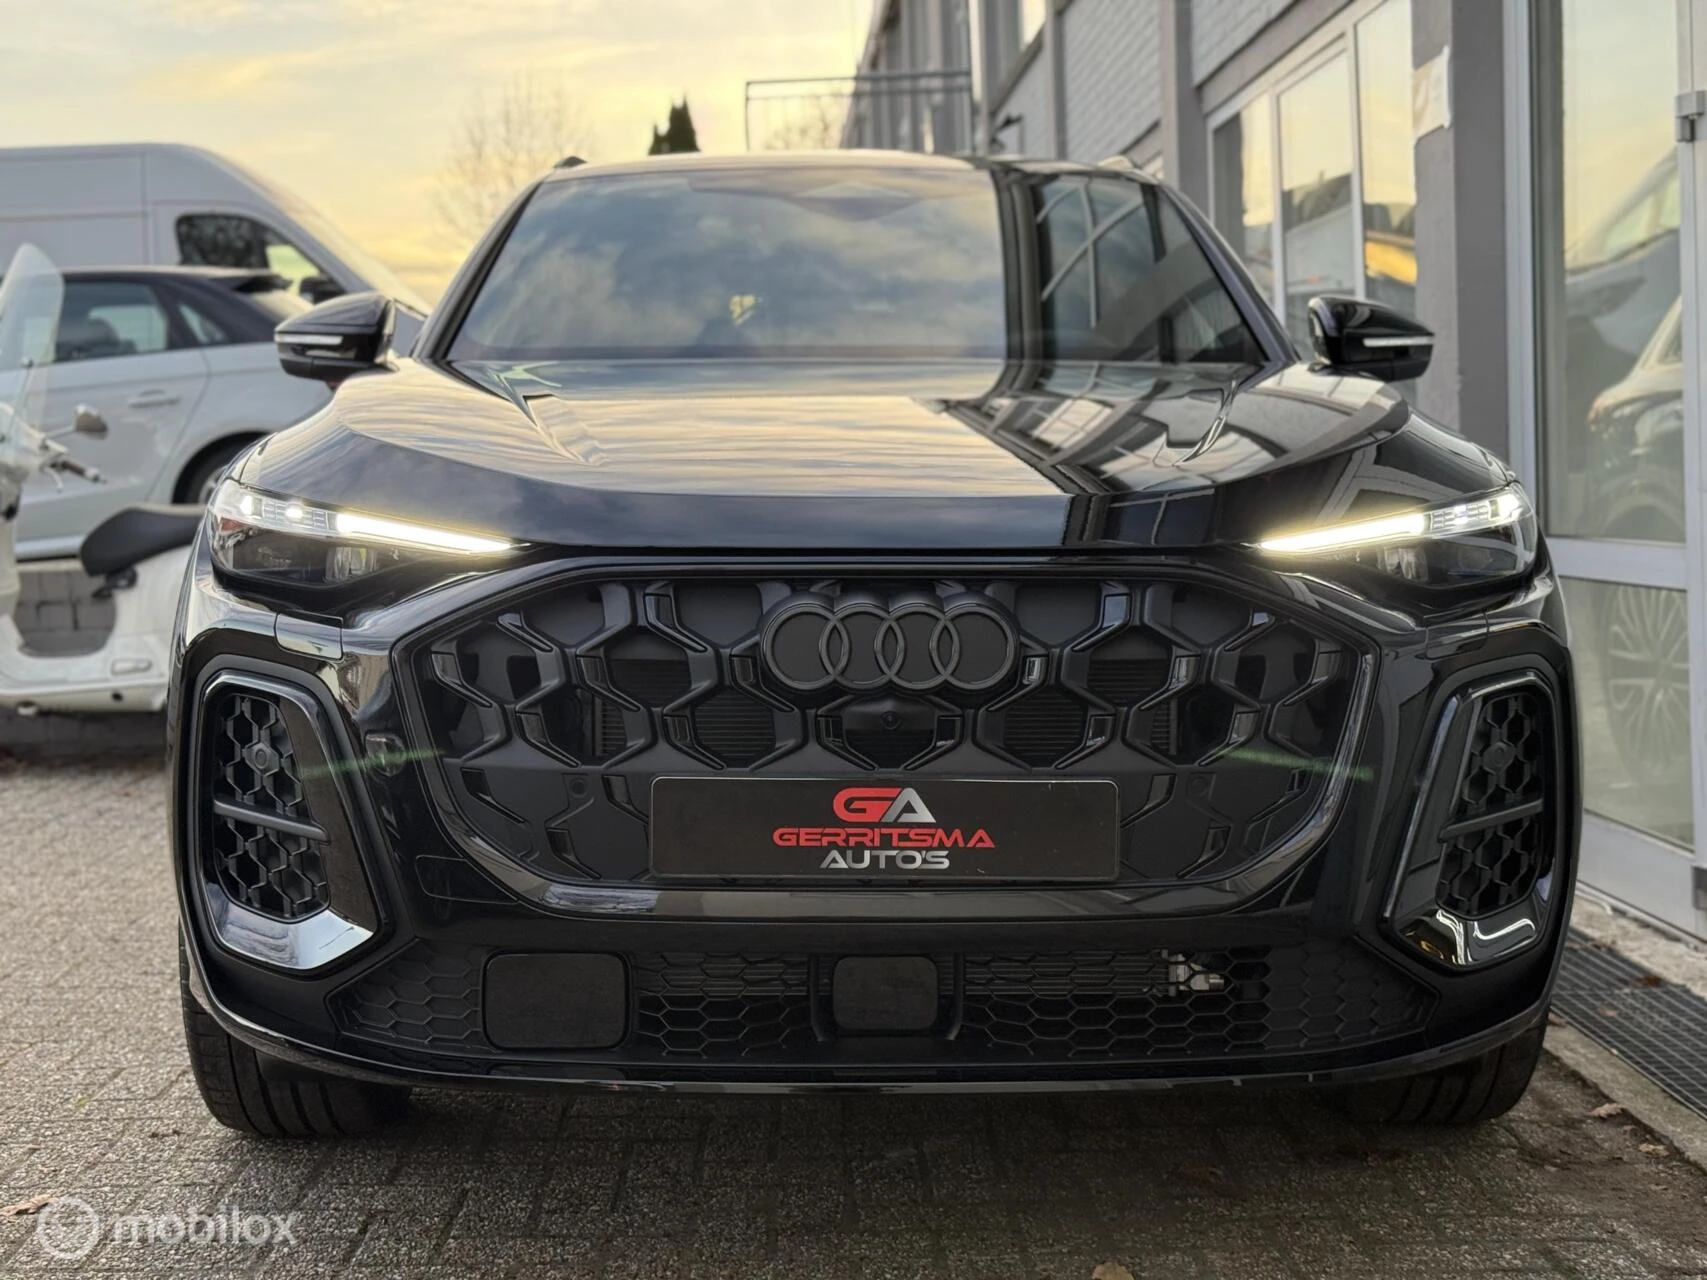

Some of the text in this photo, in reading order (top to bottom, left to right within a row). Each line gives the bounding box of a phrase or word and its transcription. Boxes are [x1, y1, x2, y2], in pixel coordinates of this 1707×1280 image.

[833, 787, 936, 823] GA
[773, 828, 995, 848] GERRITSMA
[820, 849, 950, 869] AUTO'S
